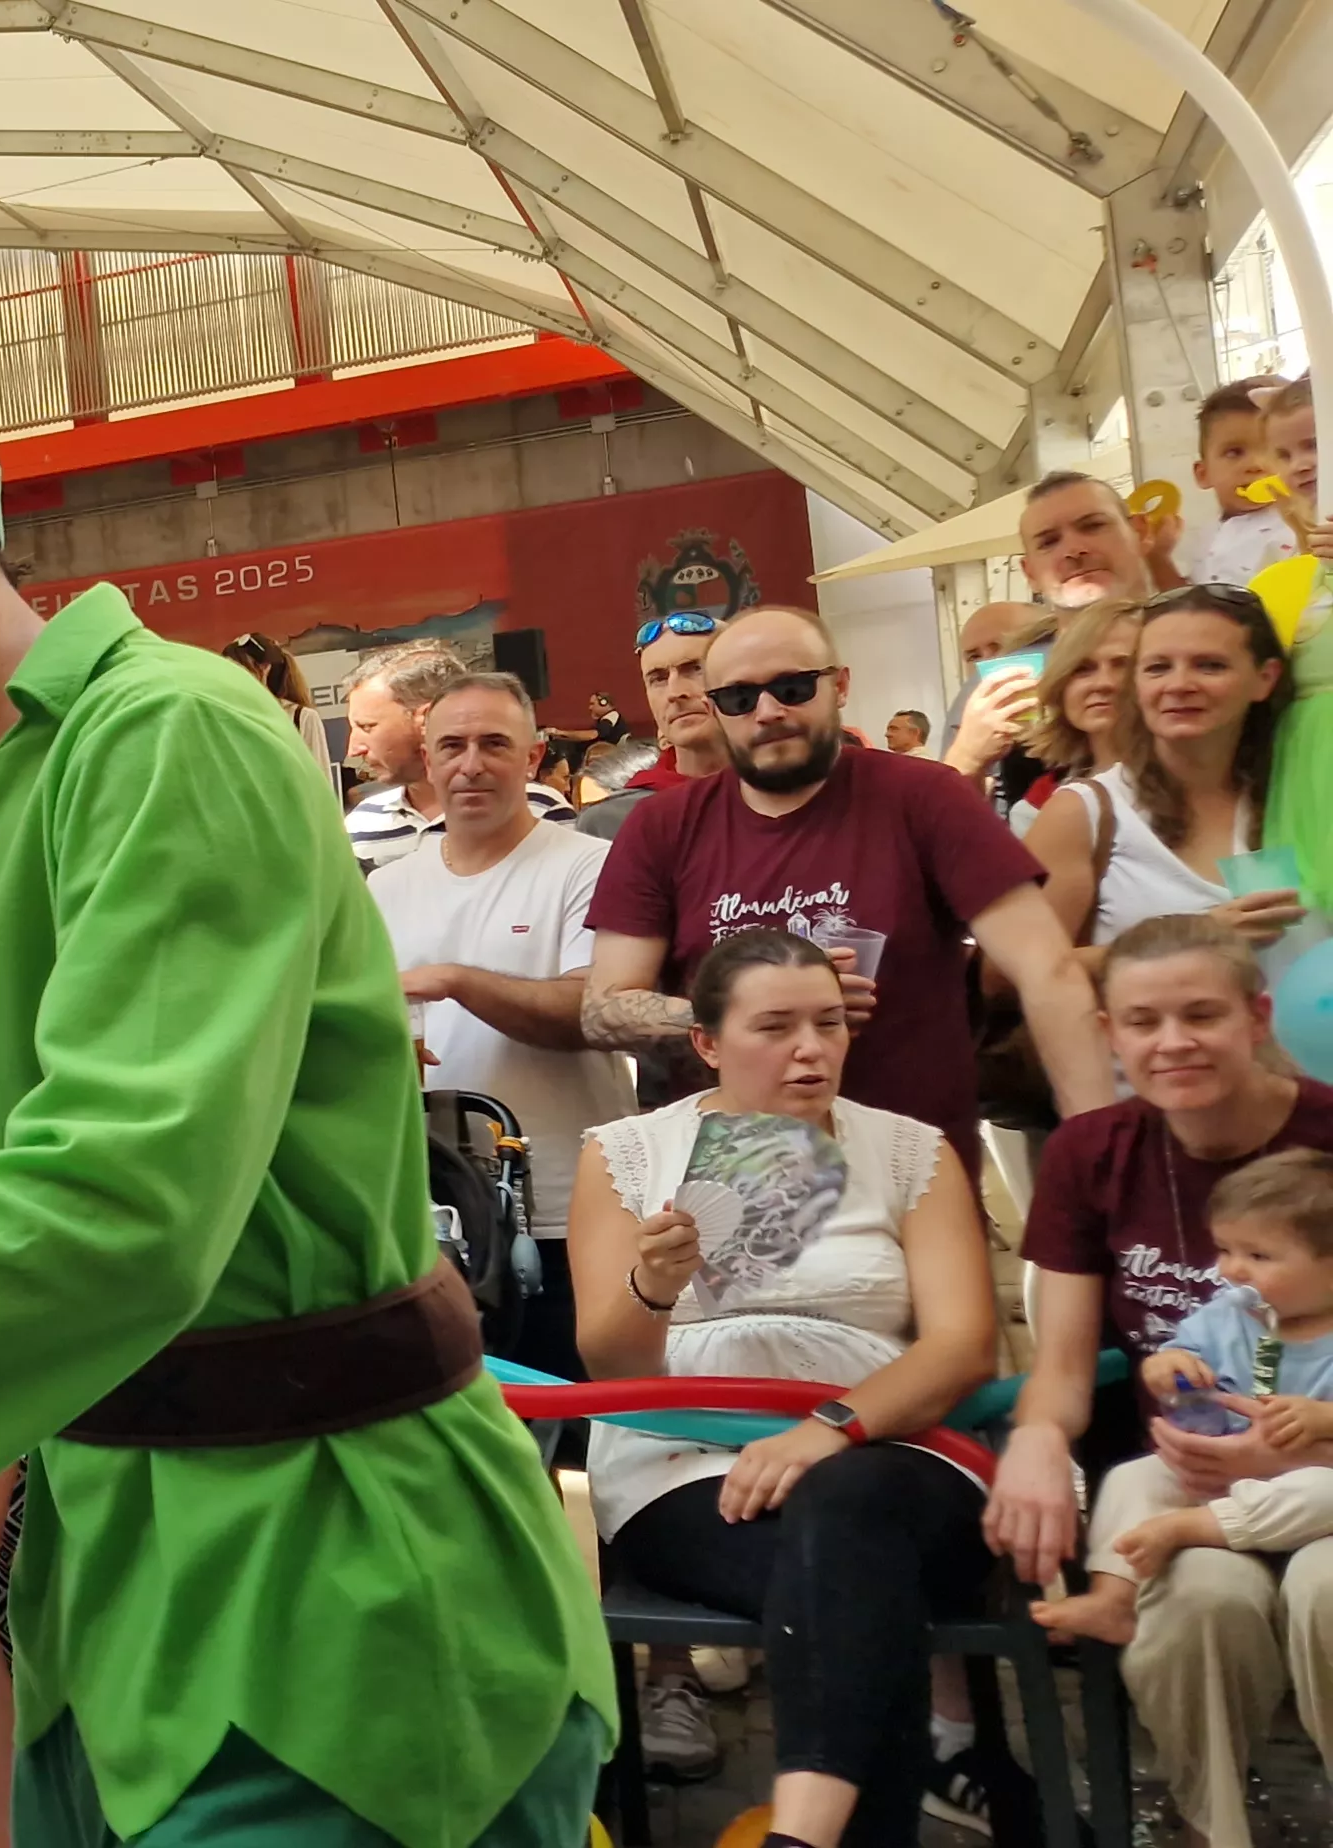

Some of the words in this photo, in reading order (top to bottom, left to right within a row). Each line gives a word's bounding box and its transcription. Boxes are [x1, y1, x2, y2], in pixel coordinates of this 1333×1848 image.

[32, 576, 198, 614] FITAS
[215, 555, 314, 595] 2025
[710, 882, 850, 922] Almudévar
[1120, 1244, 1221, 1285] Almud
